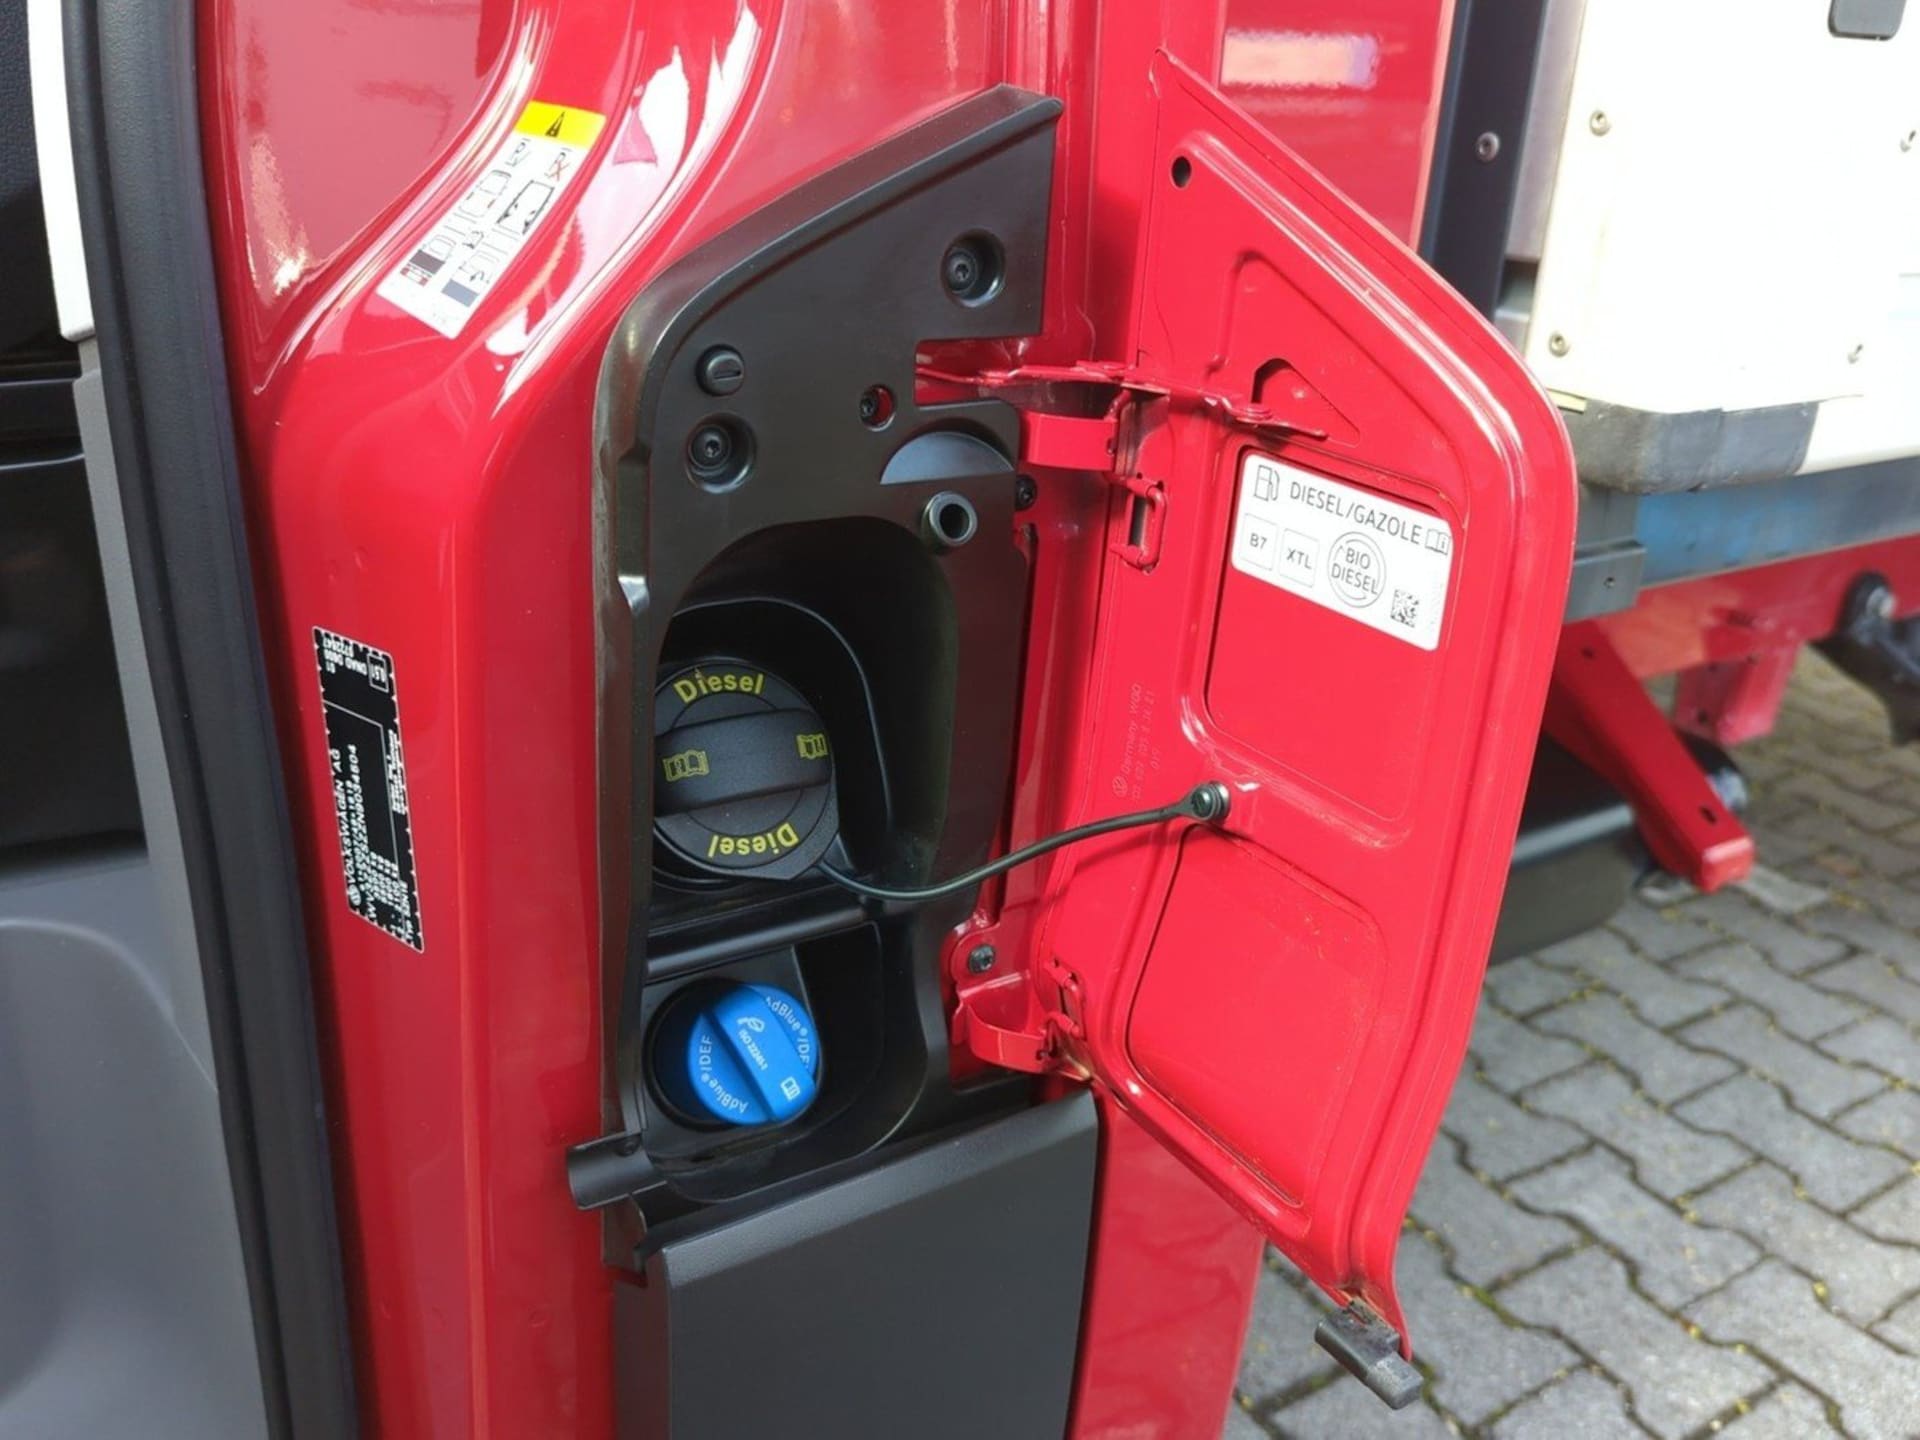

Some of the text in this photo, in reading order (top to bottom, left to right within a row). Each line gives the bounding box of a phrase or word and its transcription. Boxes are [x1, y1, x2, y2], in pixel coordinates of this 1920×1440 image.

[1290, 481, 1423, 544] DIESEL/GAZOLE
[1250, 533, 1267, 549] B7
[1287, 547, 1312, 570] XTL
[1345, 547, 1371, 570] BIO
[1331, 562, 1379, 595] DIESEL
[674, 673, 764, 704] Diesel
[330, 748, 356, 884] VOLKSWAGEN AG
[708, 822, 799, 859] Diesel
